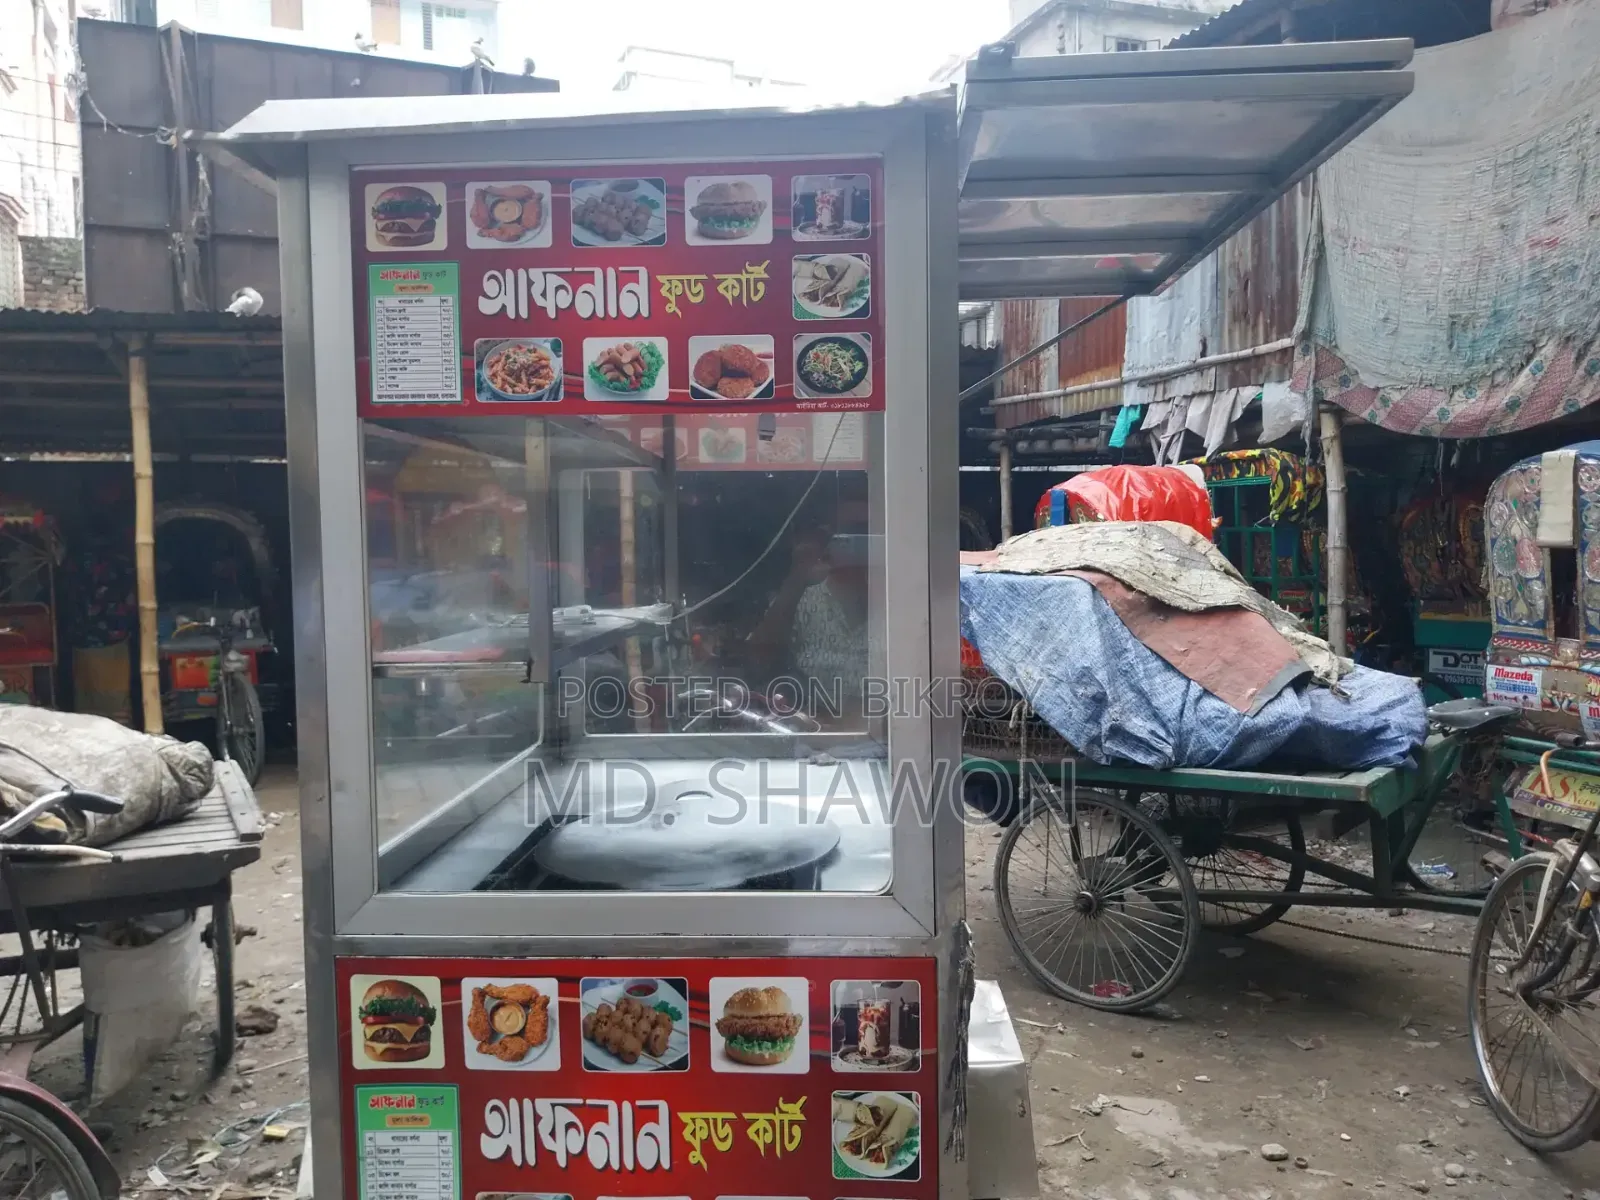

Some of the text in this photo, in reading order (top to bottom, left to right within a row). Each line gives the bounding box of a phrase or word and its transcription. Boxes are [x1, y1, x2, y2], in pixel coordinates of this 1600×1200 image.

[478, 260, 771, 320] আফনান ফুড কার্ট
[1433, 651, 1482, 668] DOT
[1494, 667, 1533, 682] Mazeda
[369, 1094, 416, 1109] আফনান
[480, 1095, 807, 1172] আফনান ফুড কার্ট
